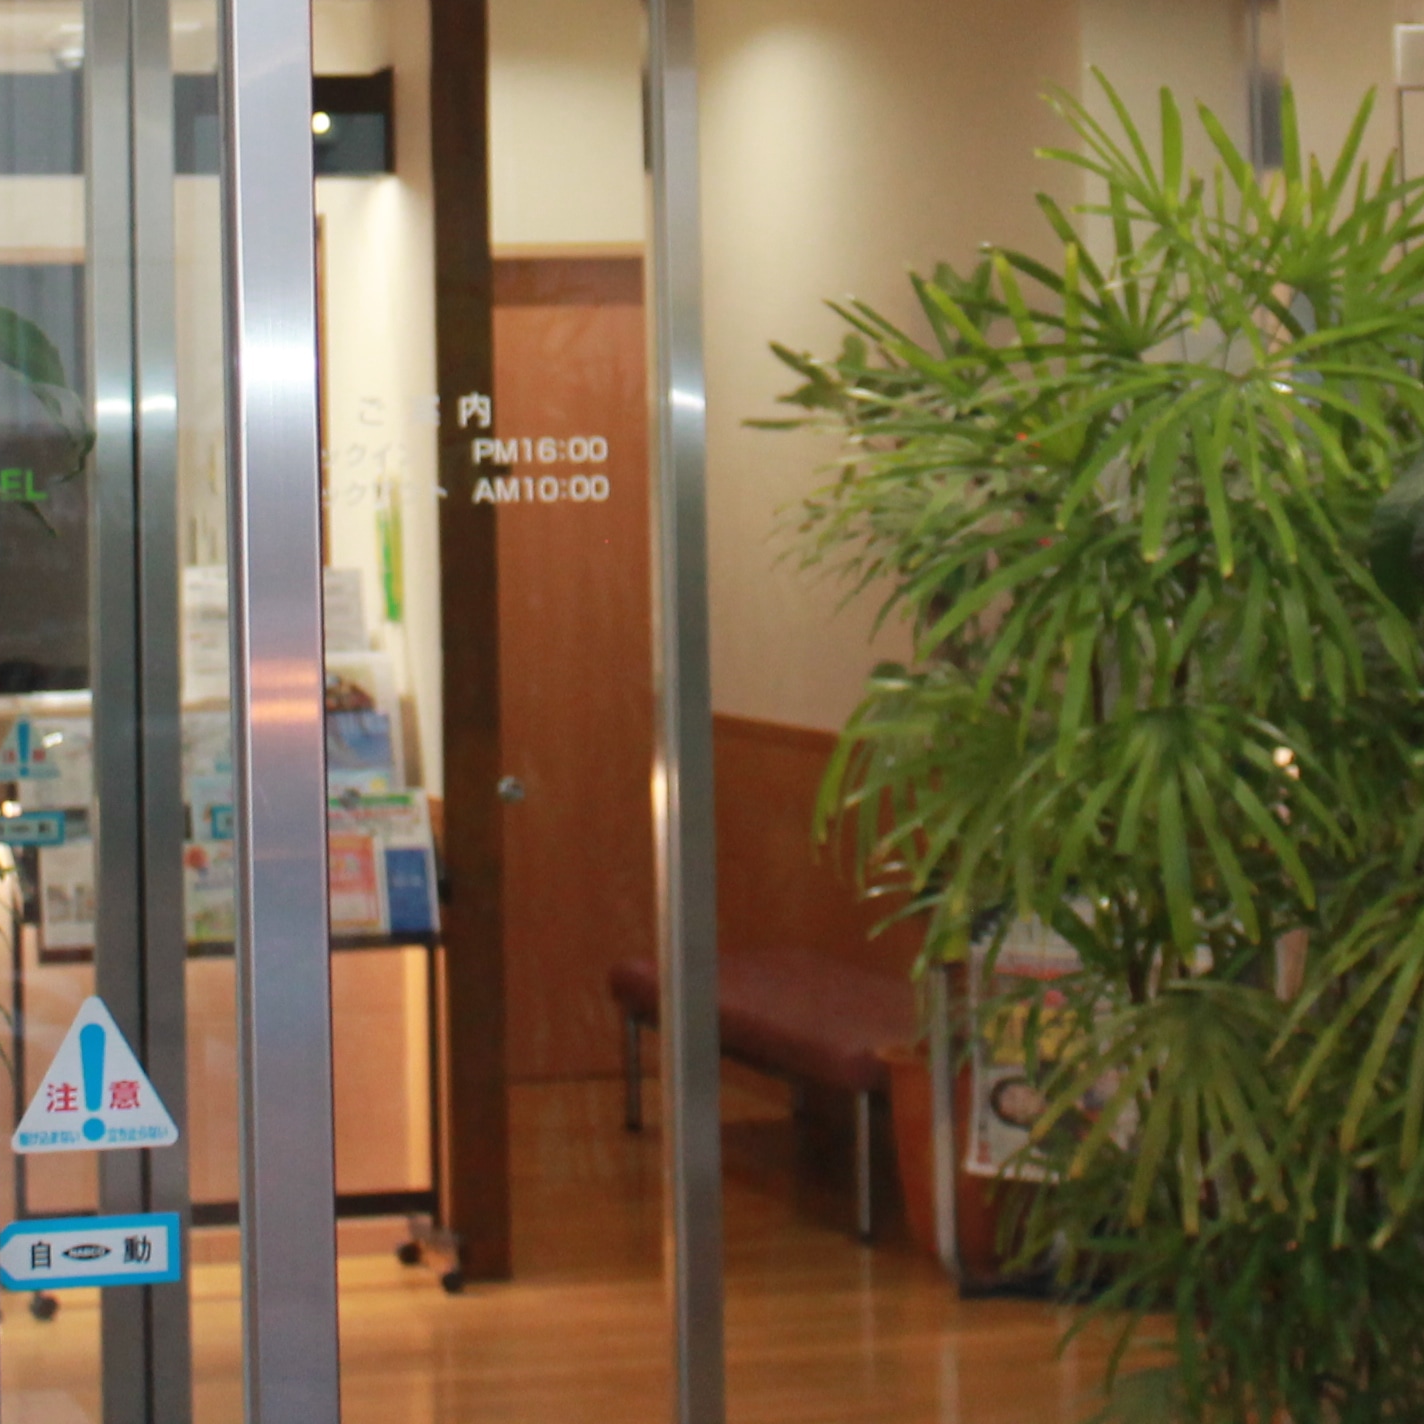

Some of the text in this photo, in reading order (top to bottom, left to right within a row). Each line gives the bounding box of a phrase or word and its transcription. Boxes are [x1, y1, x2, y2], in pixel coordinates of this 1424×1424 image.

[472, 437, 609, 465] PM16:00
[472, 475, 610, 503] AM10:00
[31, 1240, 52, 1270] 自
